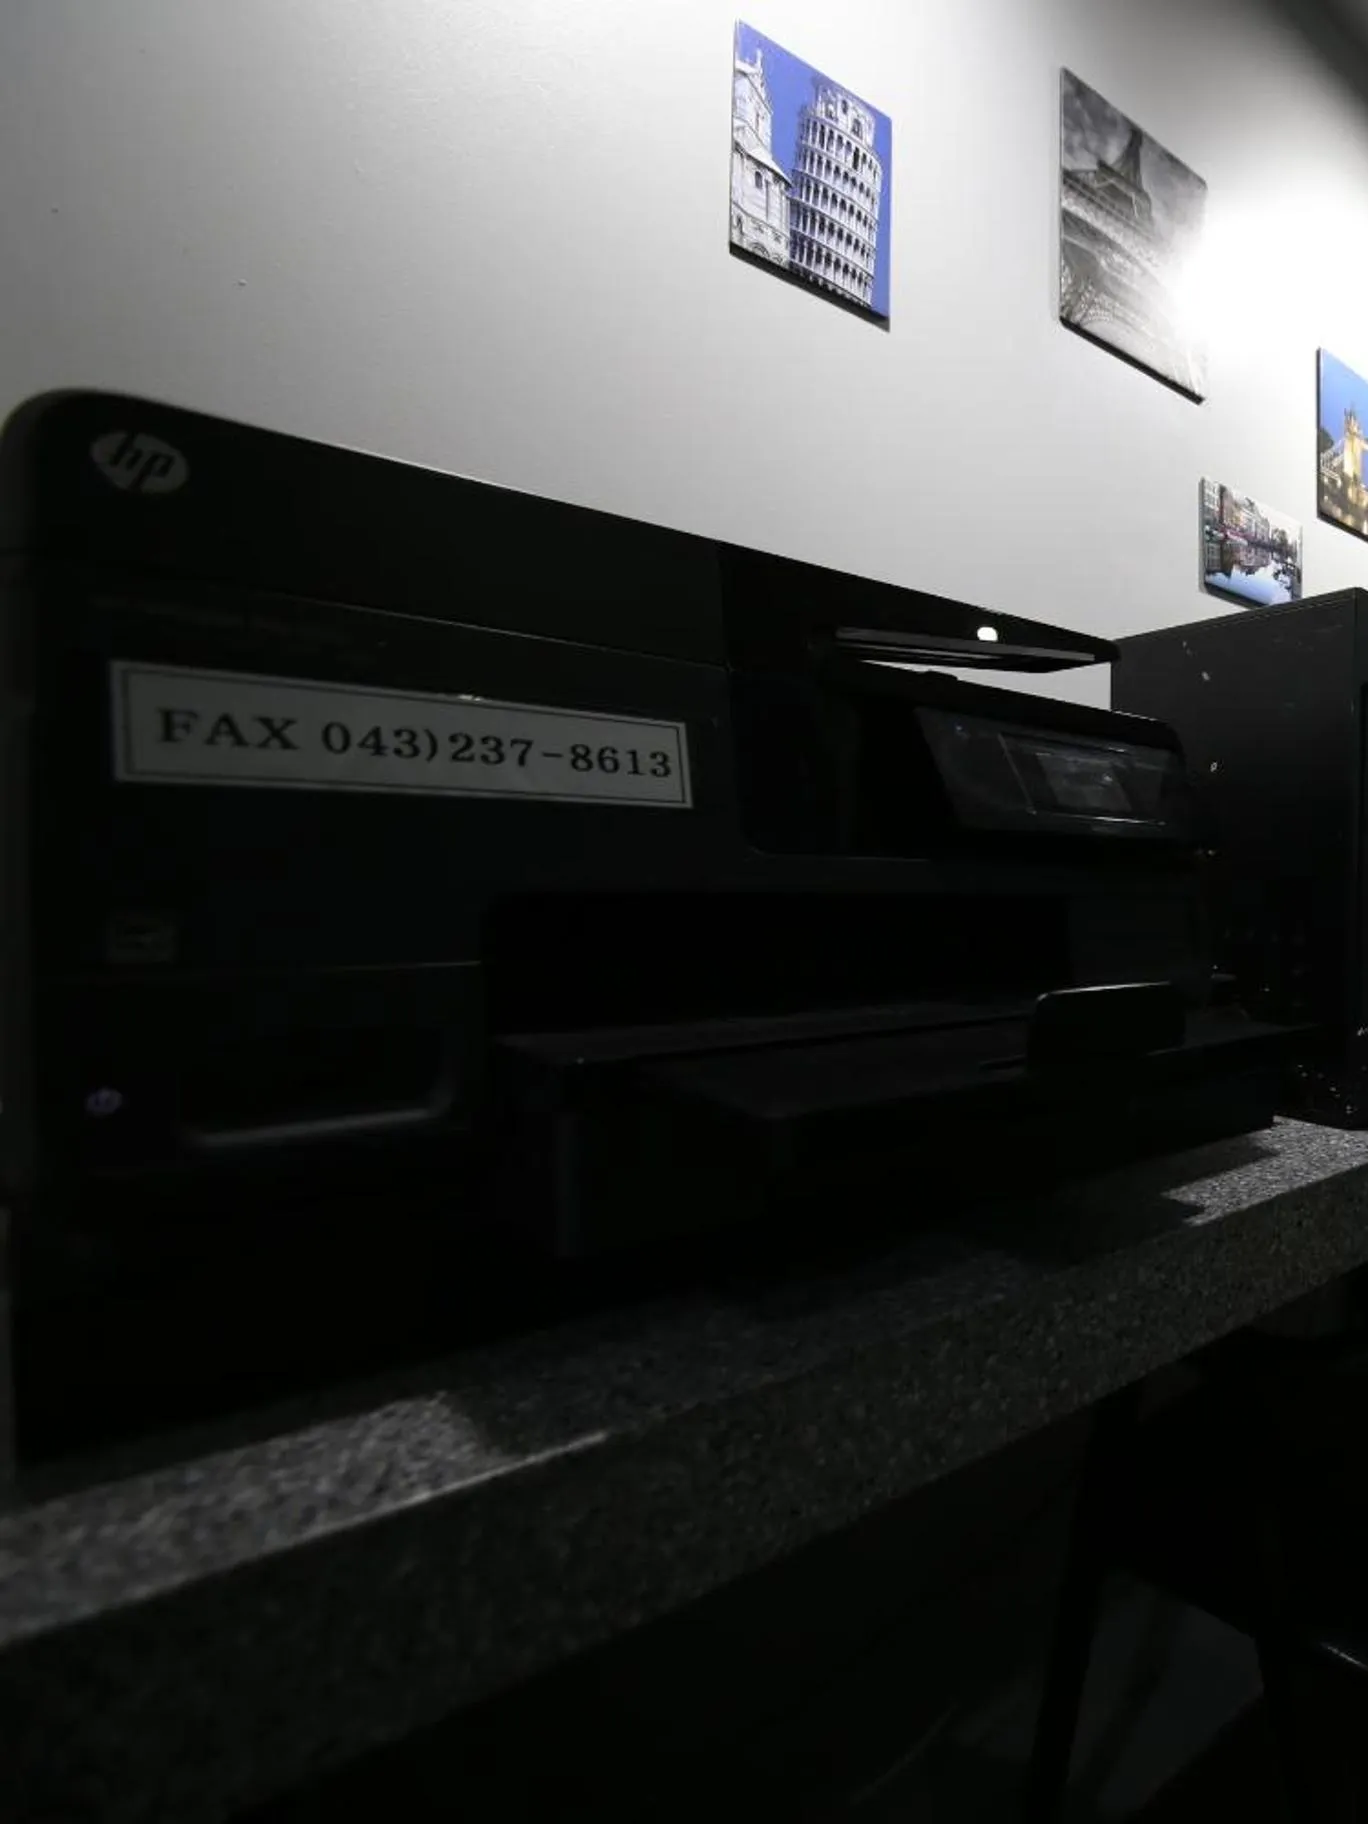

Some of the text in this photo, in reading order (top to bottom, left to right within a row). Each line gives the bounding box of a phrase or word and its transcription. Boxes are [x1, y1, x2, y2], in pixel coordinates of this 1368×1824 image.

[107, 430, 175, 491] hp
[156, 706, 673, 779] FAX 043)237-8613
